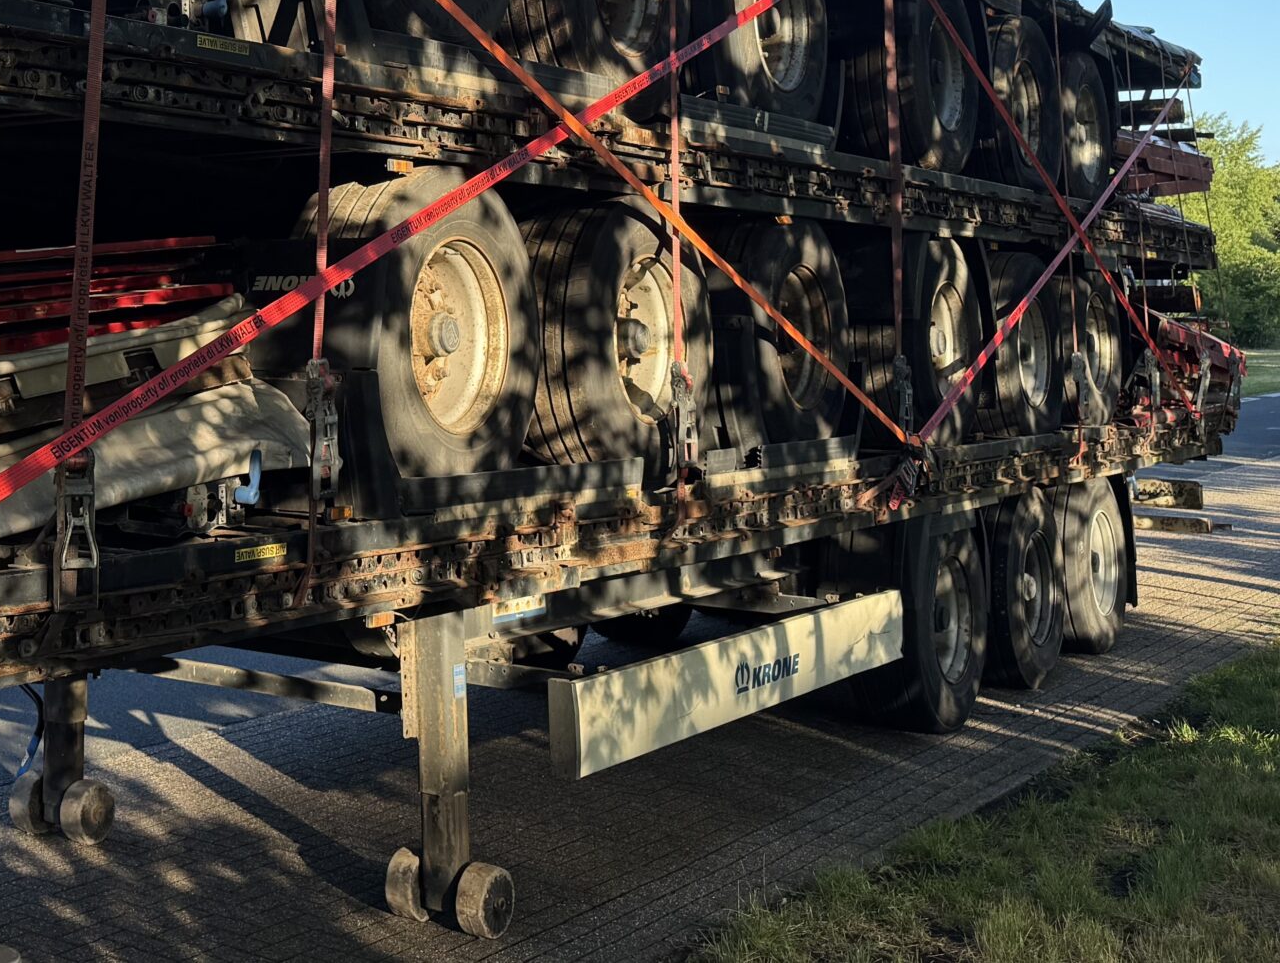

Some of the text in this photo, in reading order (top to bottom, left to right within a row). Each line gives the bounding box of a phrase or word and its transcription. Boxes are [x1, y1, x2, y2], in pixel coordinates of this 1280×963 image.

[82, 142, 94, 201] WALTER
[81, 203, 91, 236] LKW
[51, 419, 105, 460] EIGENTUM
[103, 386, 160, 426] von/property
[213, 335, 234, 353] LKW
[232, 314, 265, 341] WALTER
[236, 549, 255, 561] VALVE
[752, 653, 800, 689] KRONE
